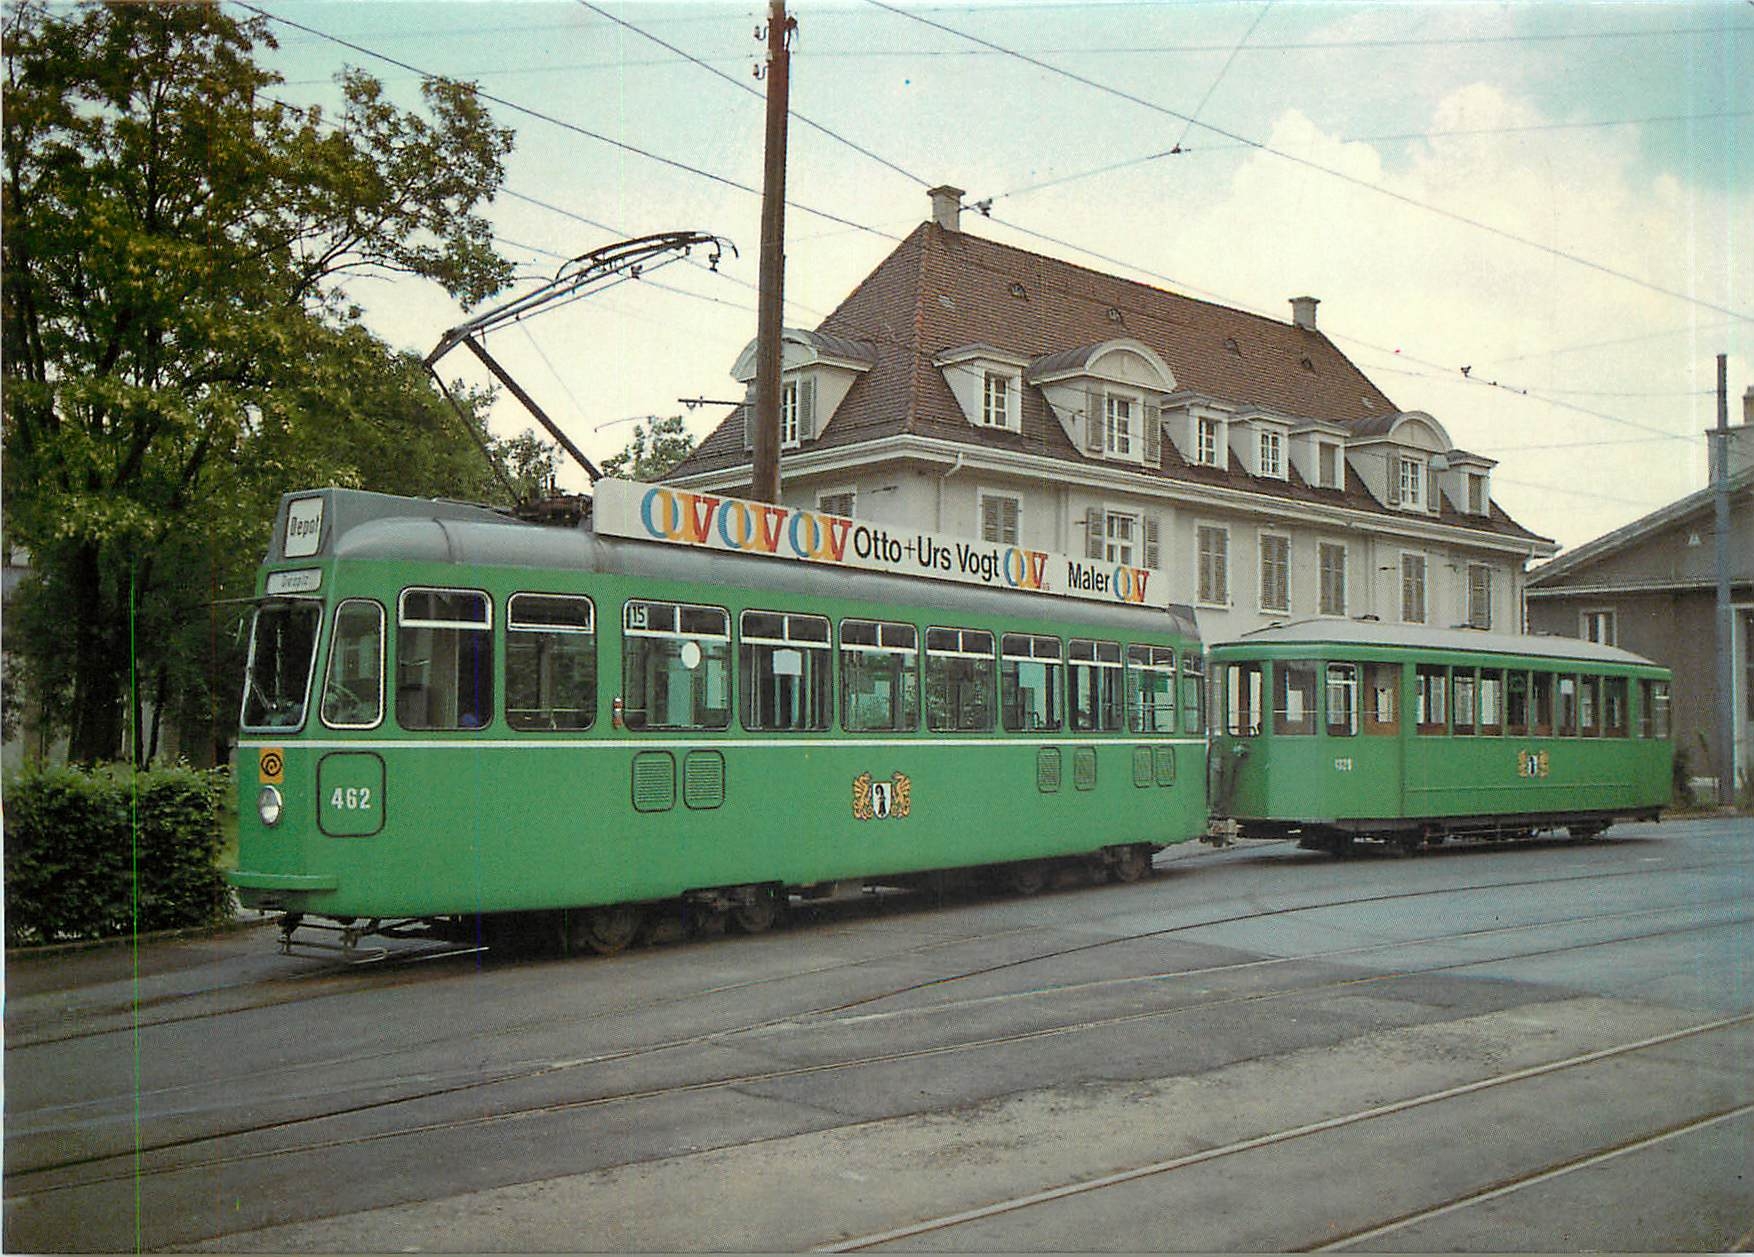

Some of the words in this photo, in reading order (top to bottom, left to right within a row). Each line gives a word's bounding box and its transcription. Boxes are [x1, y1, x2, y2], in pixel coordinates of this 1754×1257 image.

[290, 514, 320, 538] Depot
[956, 542, 999, 582] Vogt
[1068, 561, 1110, 592] Maler
[632, 605, 645, 623] 15
[331, 787, 371, 809] 462
